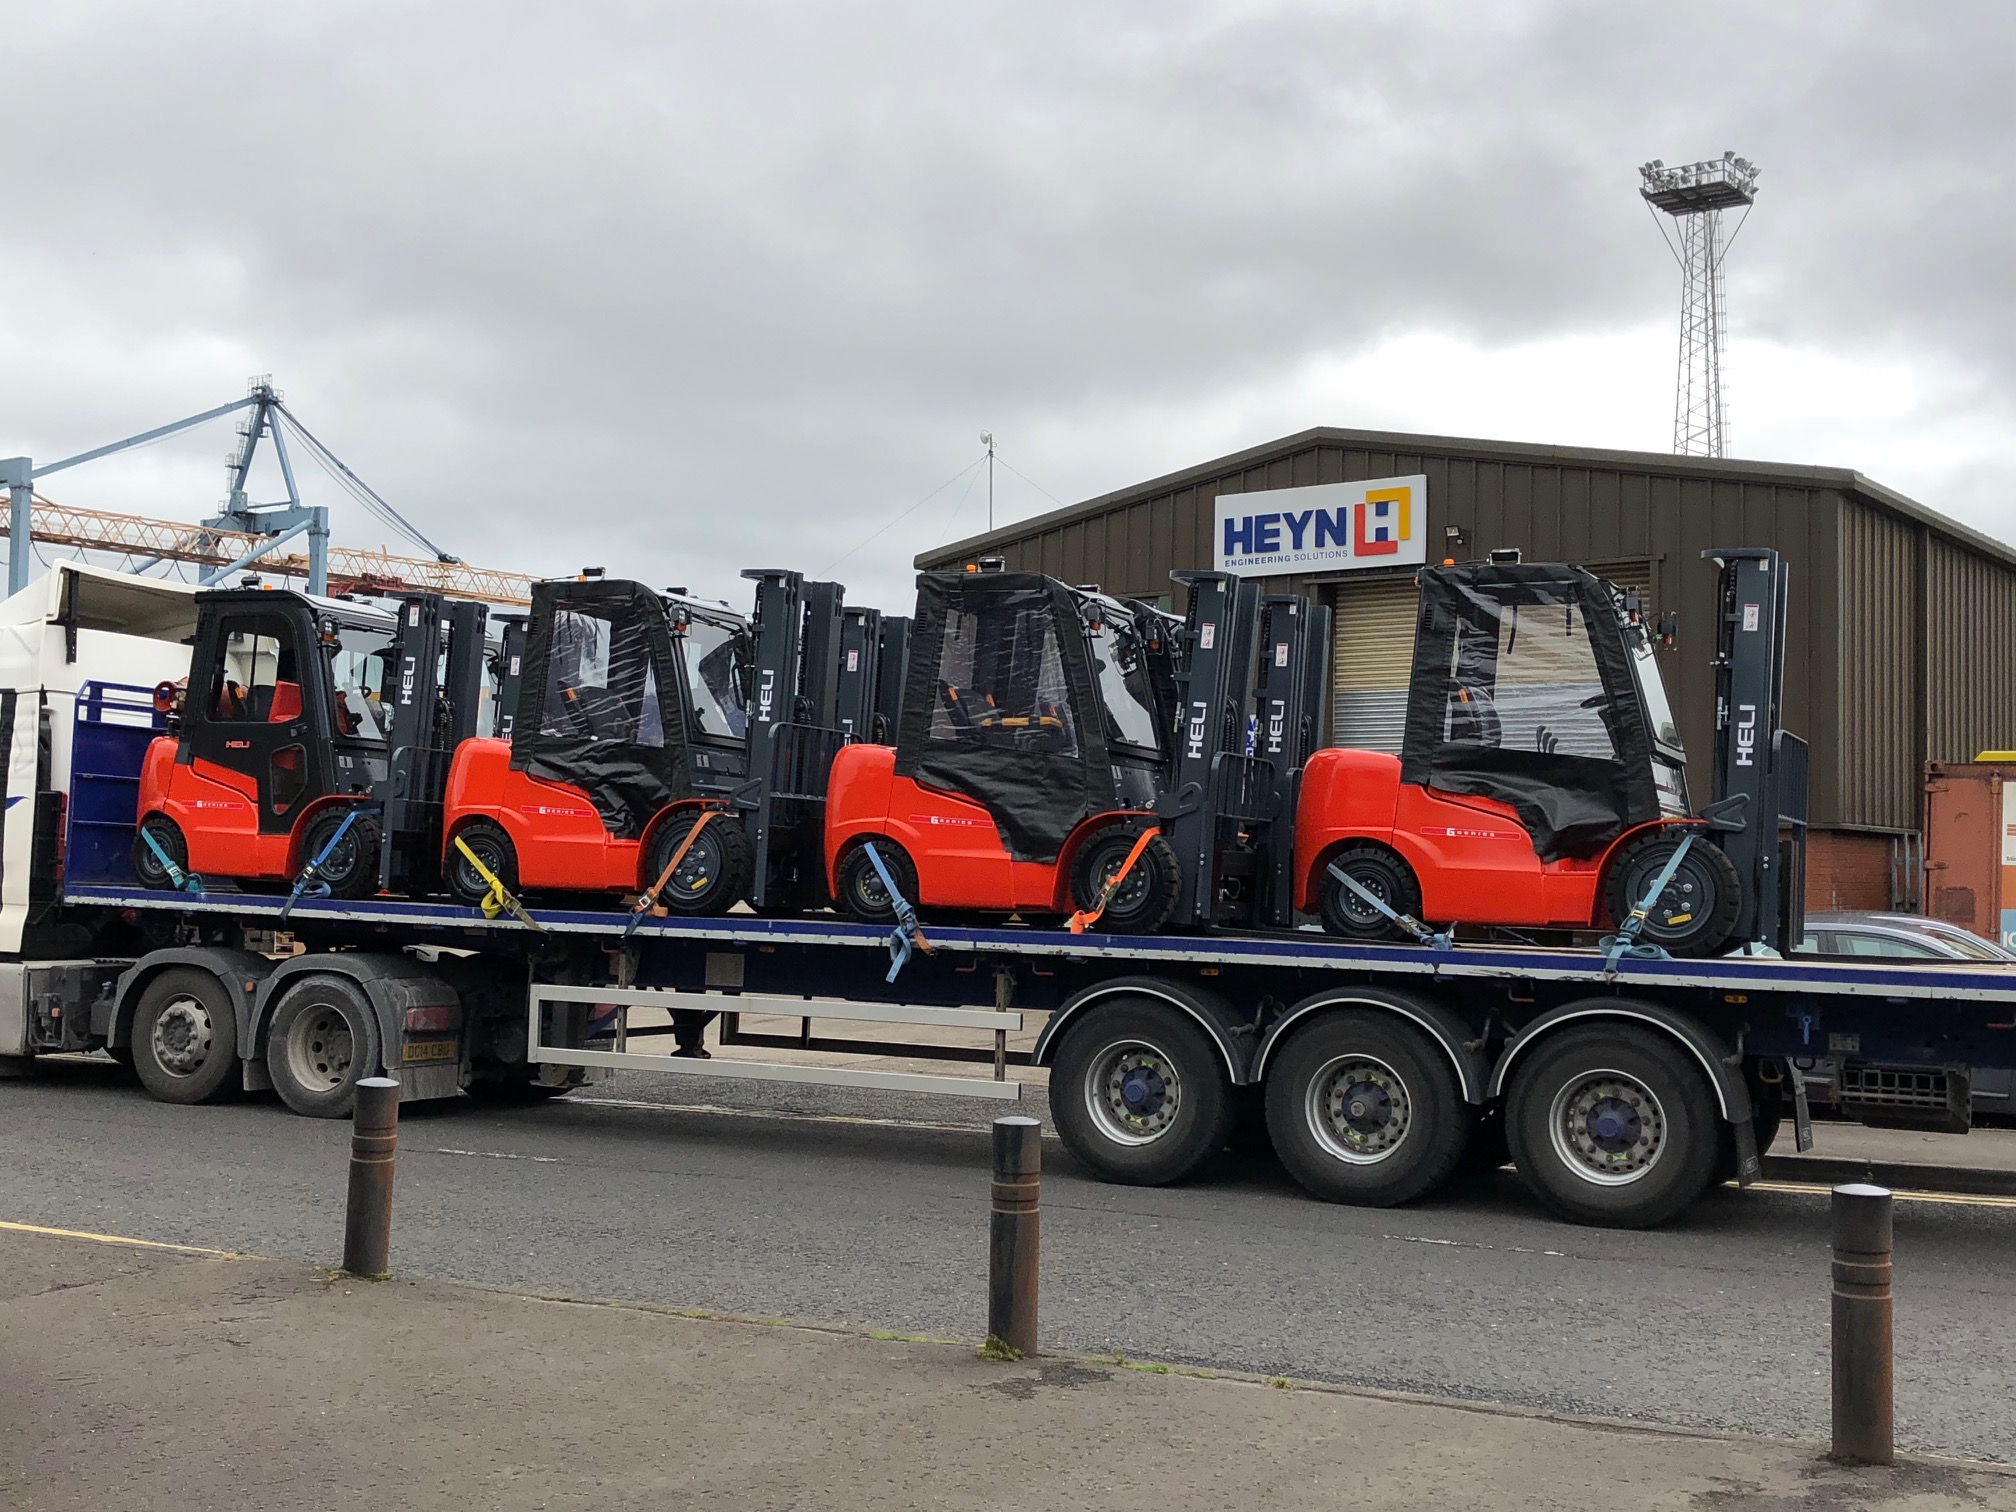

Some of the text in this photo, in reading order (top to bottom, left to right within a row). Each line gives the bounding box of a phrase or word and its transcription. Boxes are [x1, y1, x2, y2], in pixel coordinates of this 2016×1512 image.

[1223, 506, 1347, 556] HEYN
[1224, 549, 1348, 568] ENGINEERING SOLUTIONS
[401, 656, 416, 705] HELI
[758, 669, 775, 722] HELI
[225, 740, 251, 749] HELI
[1187, 701, 1207, 759] HELI
[1268, 700, 1285, 753] HELI
[1736, 704, 1756, 766] HELI
